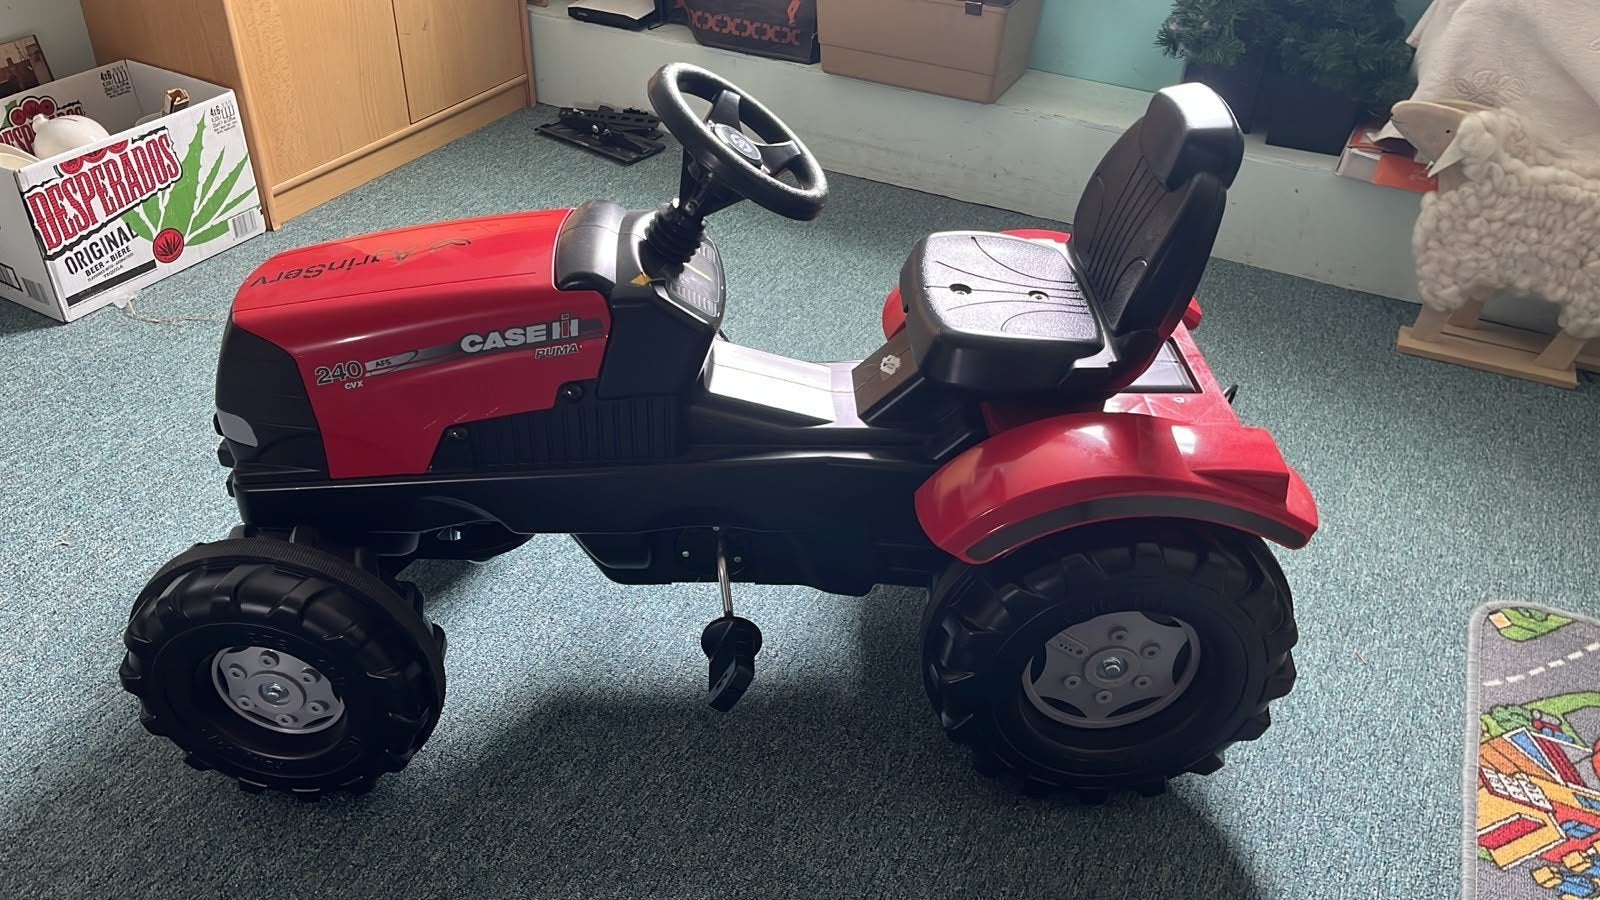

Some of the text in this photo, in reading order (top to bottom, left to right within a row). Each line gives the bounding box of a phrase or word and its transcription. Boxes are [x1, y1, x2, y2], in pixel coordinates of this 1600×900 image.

[26, 133, 180, 250] DESPERADOS
[64, 222, 138, 275] ORIGINAL
[85, 262, 105, 277] BEER
[110, 245, 131, 262] BIÈRE
[461, 324, 546, 353] CASE
[534, 343, 578, 359] PUMA
[314, 359, 392, 385] 240 AFS
[344, 381, 364, 389] CVX
